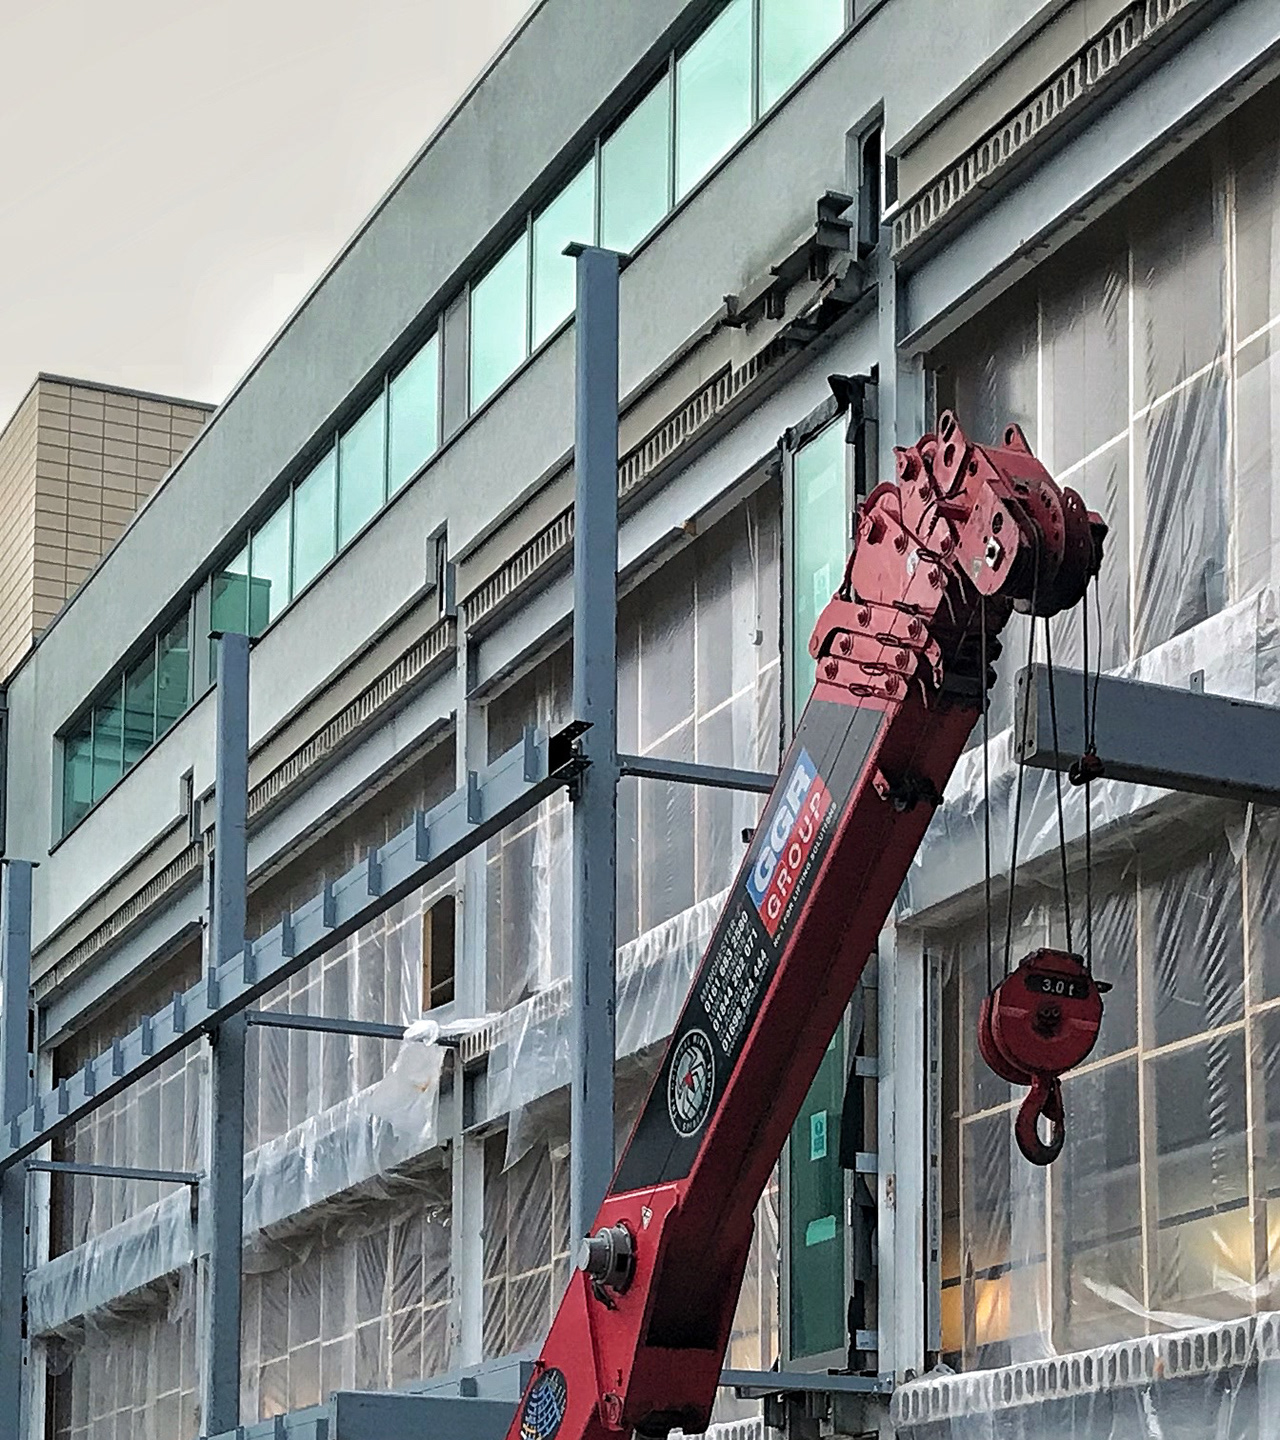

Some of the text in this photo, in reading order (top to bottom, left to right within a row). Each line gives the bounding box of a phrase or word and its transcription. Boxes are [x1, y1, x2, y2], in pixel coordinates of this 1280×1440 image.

[754, 764, 811, 893] GGR
[768, 792, 821, 920] GROUP
[810, 801, 838, 862] SOLUTIONS
[704, 911, 749, 1013] 0161 683 2580
[712, 928, 758, 1032] 01844 202 071
[740, 978, 755, 1007] 824
[753, 949, 767, 978] 444
[1042, 978, 1065, 994] 3.0
